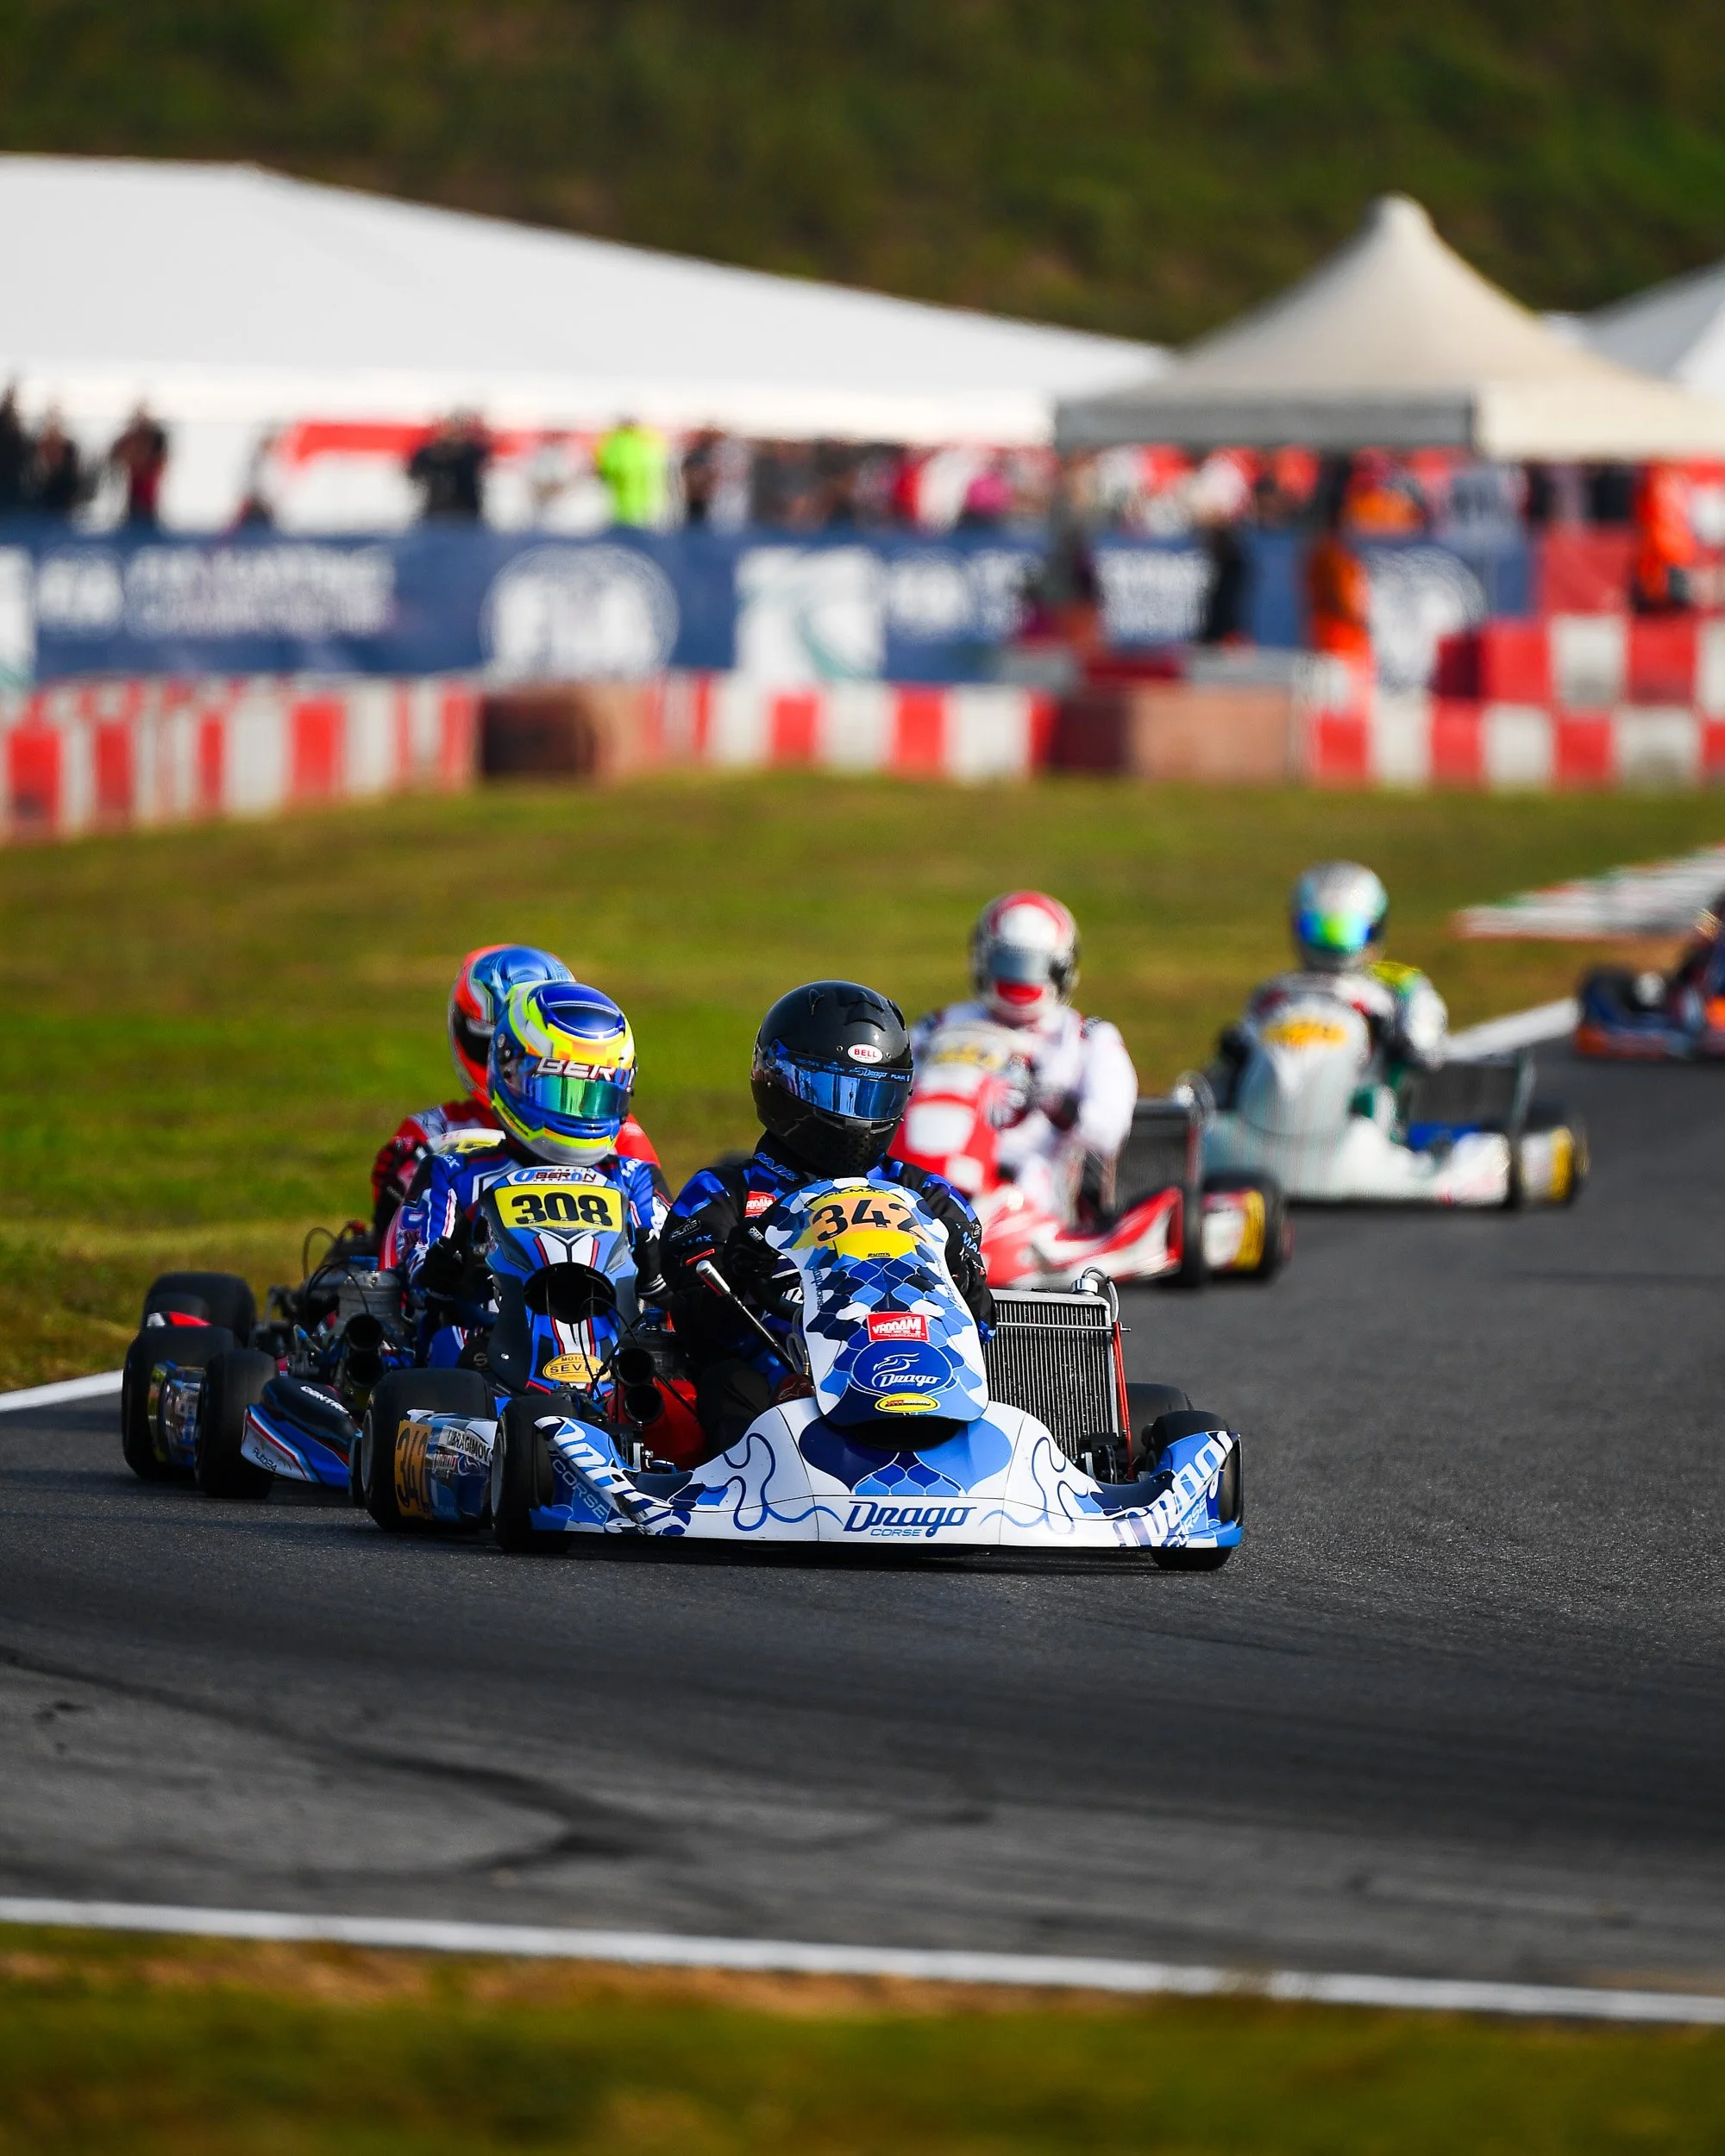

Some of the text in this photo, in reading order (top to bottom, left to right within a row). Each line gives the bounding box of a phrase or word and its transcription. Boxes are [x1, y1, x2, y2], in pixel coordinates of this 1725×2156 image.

[854, 1048, 878, 1058] BELL
[511, 1192, 613, 1226] 308
[812, 1199, 926, 1243] 342
[879, 1373, 942, 1388] Drago
[553, 1458, 608, 1520] CORSE
[844, 1501, 977, 1538] Drago
[870, 1528, 922, 1537] CORSE
